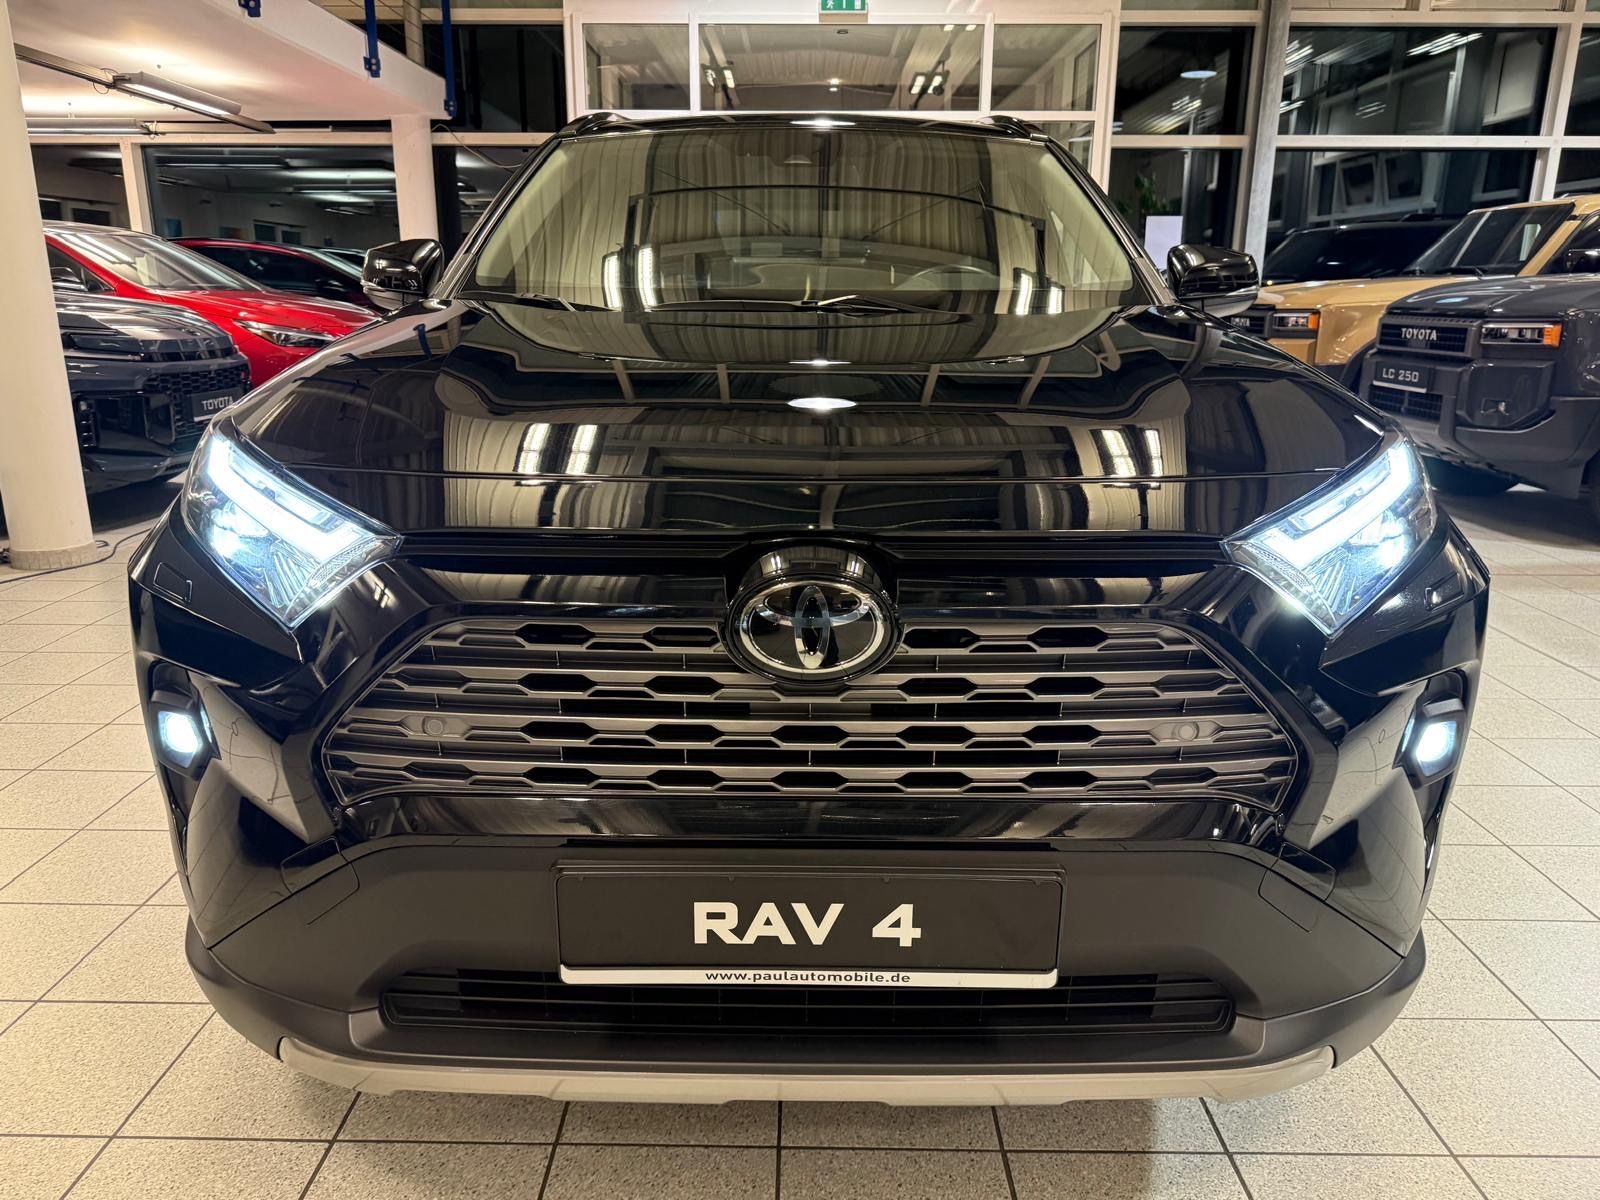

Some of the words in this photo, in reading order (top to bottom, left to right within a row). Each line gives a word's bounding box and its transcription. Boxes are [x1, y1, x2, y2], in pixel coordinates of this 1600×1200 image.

[1401, 327, 1437, 341] TOYOTA
[1382, 367, 1396, 379] LC
[1398, 369, 1419, 383] 250
[201, 396, 234, 411] TOYOTA
[693, 901, 845, 945] RAV
[872, 903, 922, 948] 4
[705, 971, 911, 983] www.paulautomobile.de
